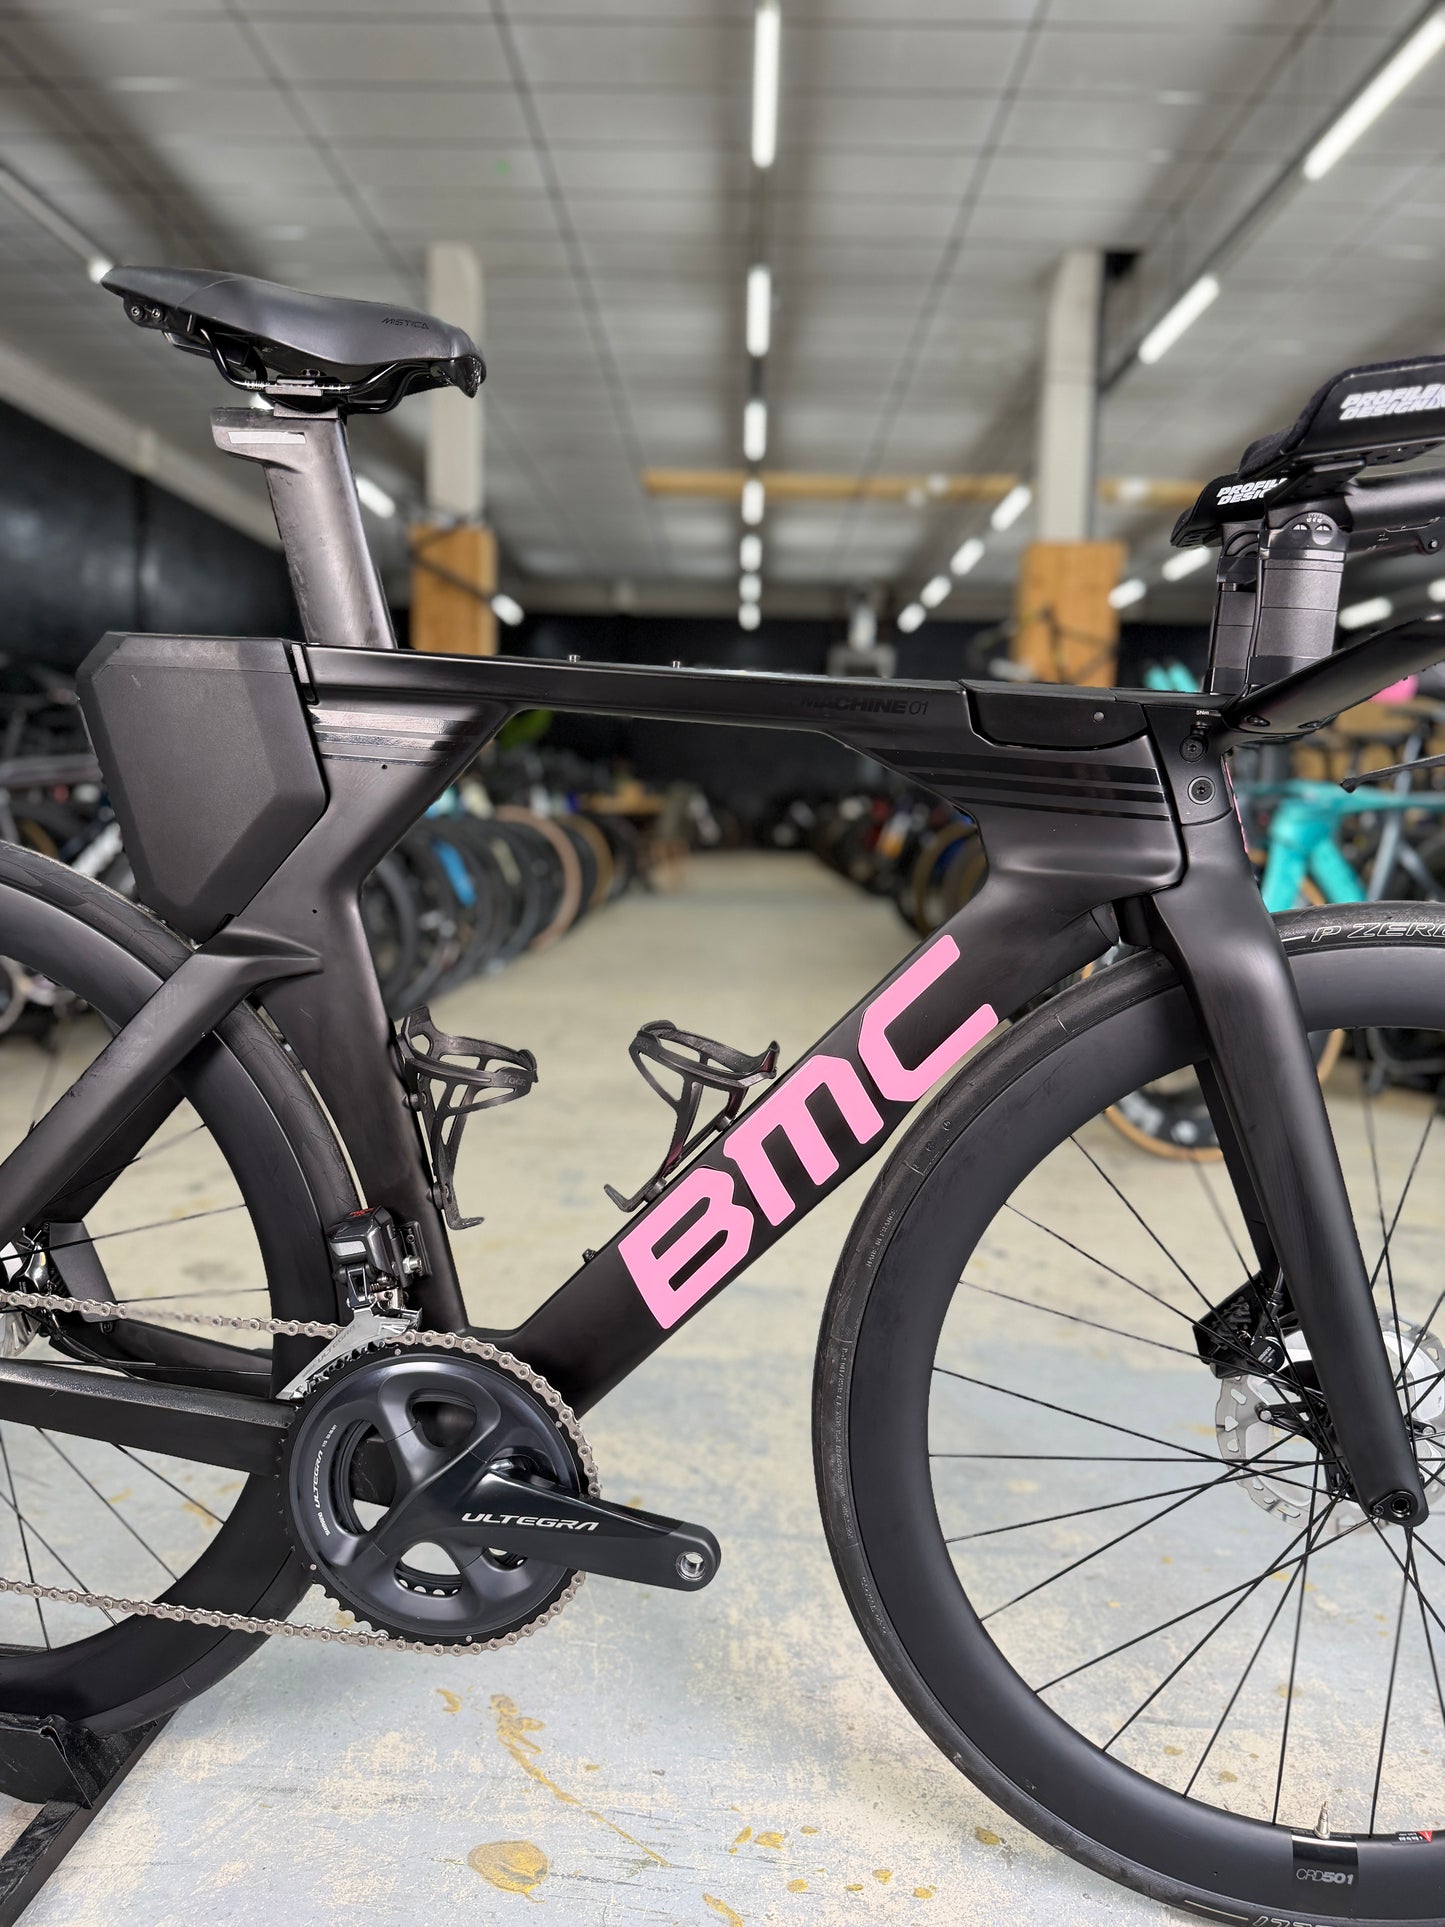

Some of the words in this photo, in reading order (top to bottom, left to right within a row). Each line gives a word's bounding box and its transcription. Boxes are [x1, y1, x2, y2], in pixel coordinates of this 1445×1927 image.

[381, 318, 430, 330] MISTICA
[1340, 383, 1442, 409] PROFILE
[1311, 925, 1342, 943] P
[618, 934, 999, 1330] BMC
[312, 1450, 324, 1509] ULTEGRA
[461, 1512, 600, 1532] ULTEGRA
